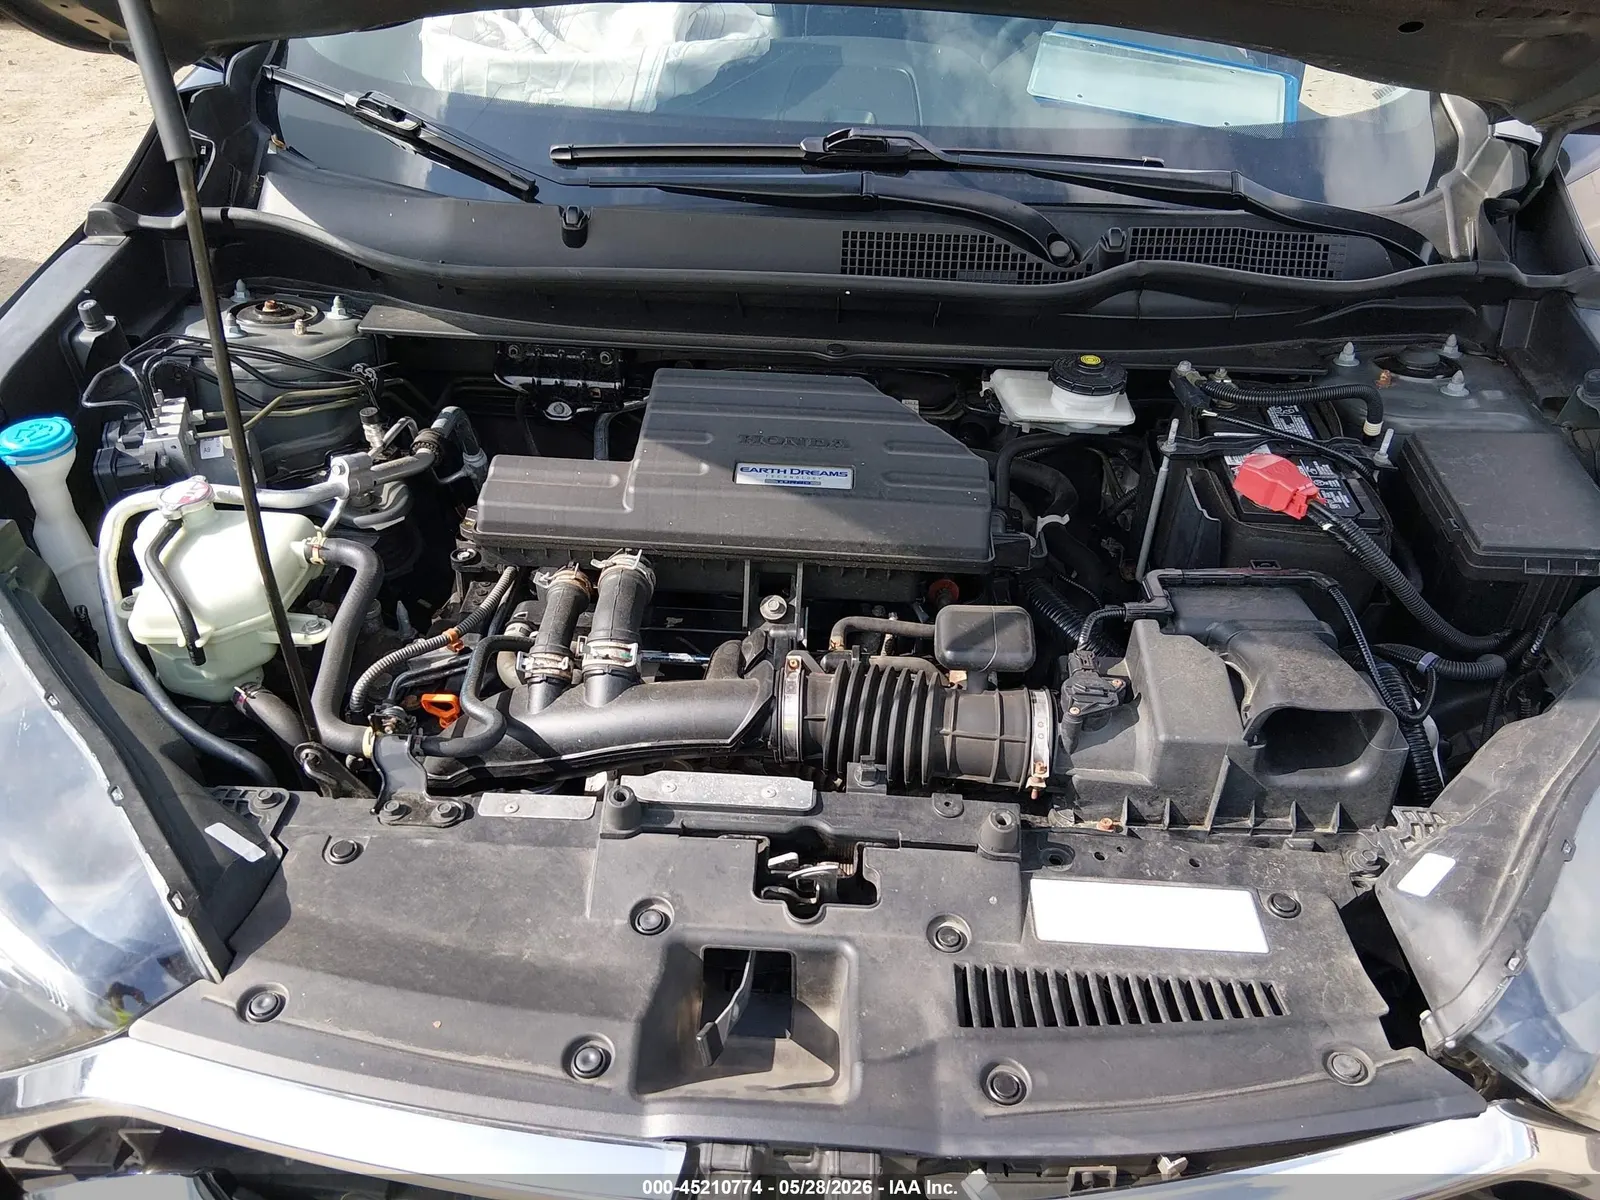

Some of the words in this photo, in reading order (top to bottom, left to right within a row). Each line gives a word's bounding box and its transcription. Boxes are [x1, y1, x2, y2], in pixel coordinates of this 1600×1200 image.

[737, 434, 851, 449] HONDA
[740, 467, 787, 475] EARTH
[790, 468, 848, 478] DREAMS
